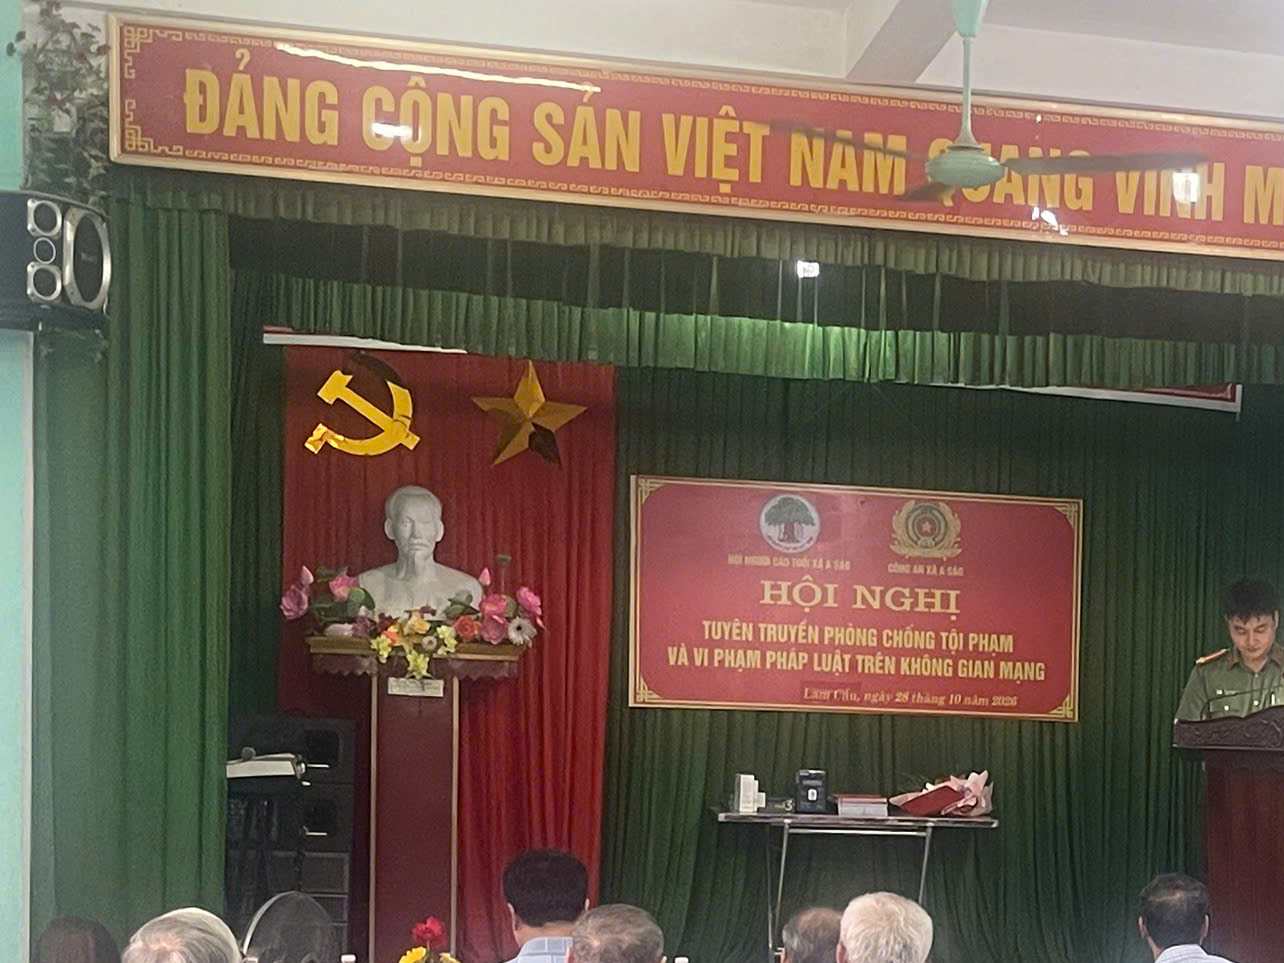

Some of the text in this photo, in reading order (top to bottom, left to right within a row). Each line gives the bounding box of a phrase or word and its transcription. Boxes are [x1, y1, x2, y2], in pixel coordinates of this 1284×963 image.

[183, 48, 338, 146] ĐẢNG
[361, 76, 510, 168] CỘNG
[532, 81, 641, 172] SẢN
[662, 104, 770, 194] VIỆT
[789, 127, 907, 195] NAM
[1115, 161, 1225, 221] VINH
[760, 574, 961, 620] HỘI NGHỊ
[702, 618, 753, 641] TUYÊN
[824, 622, 877, 646] PHÒNG
[882, 624, 936, 649] CHỐNG
[940, 628, 963, 655] TỘI
[968, 633, 1013, 656] PHẠM
[667, 643, 1045, 684] VÀ VI PHẠM PHÁP LUẬT TRÊN KHÔNG GIAN MẠNG
[949, 693, 961, 705] 10
